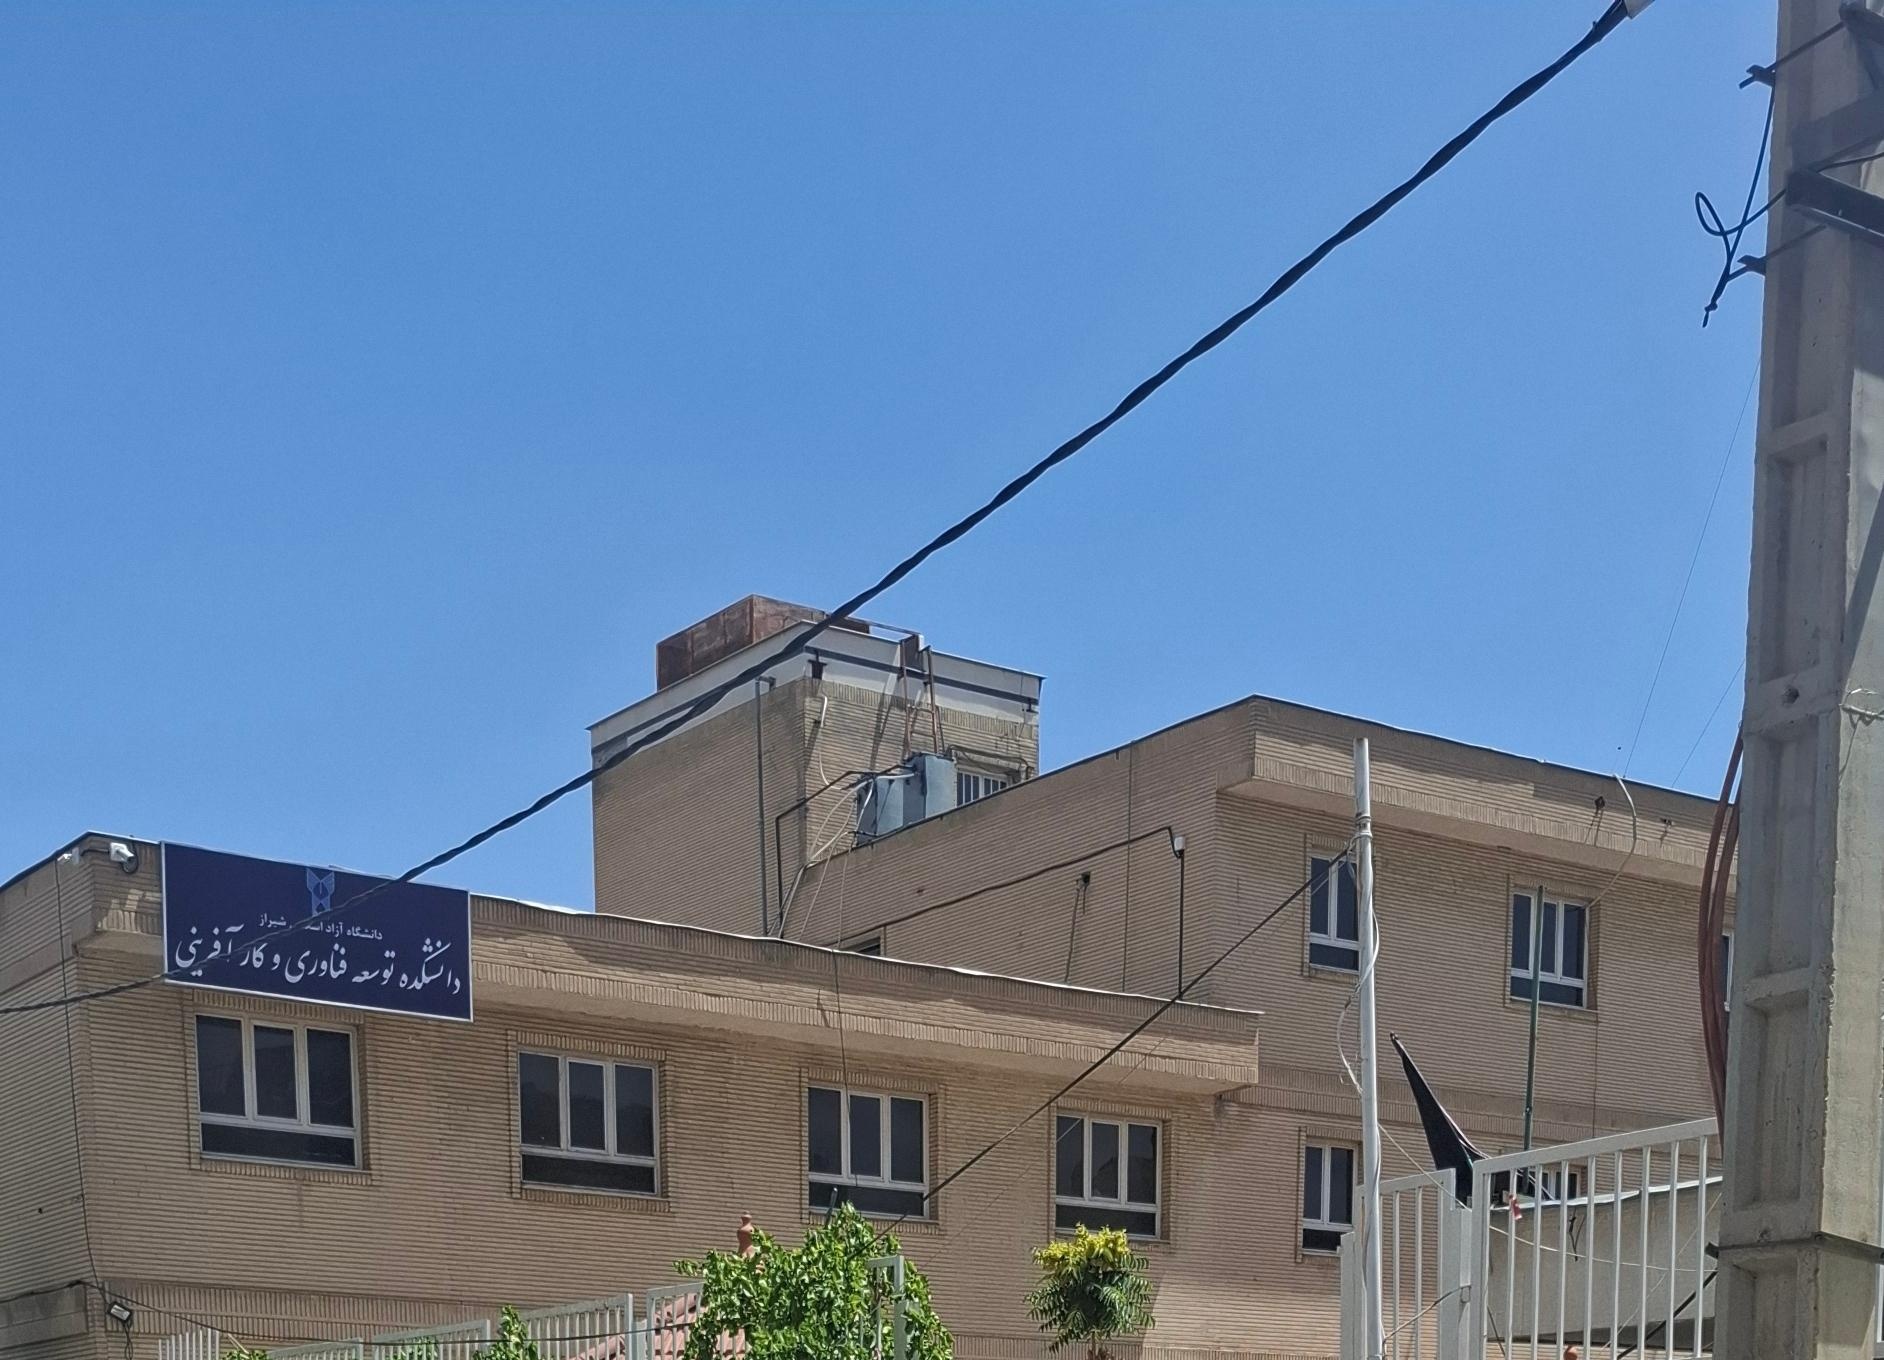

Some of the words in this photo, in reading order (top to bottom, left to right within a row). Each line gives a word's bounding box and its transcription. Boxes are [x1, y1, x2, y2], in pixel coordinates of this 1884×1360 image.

[259, 913, 287, 928] شیراز
[325, 921, 343, 938] آزاد
[346, 926, 383, 940] دانشگاه
[271, 953, 281, 970] و
[284, 943, 347, 983] فناوری
[352, 950, 396, 985] توسعه
[399, 937, 461, 995] دانشکده
